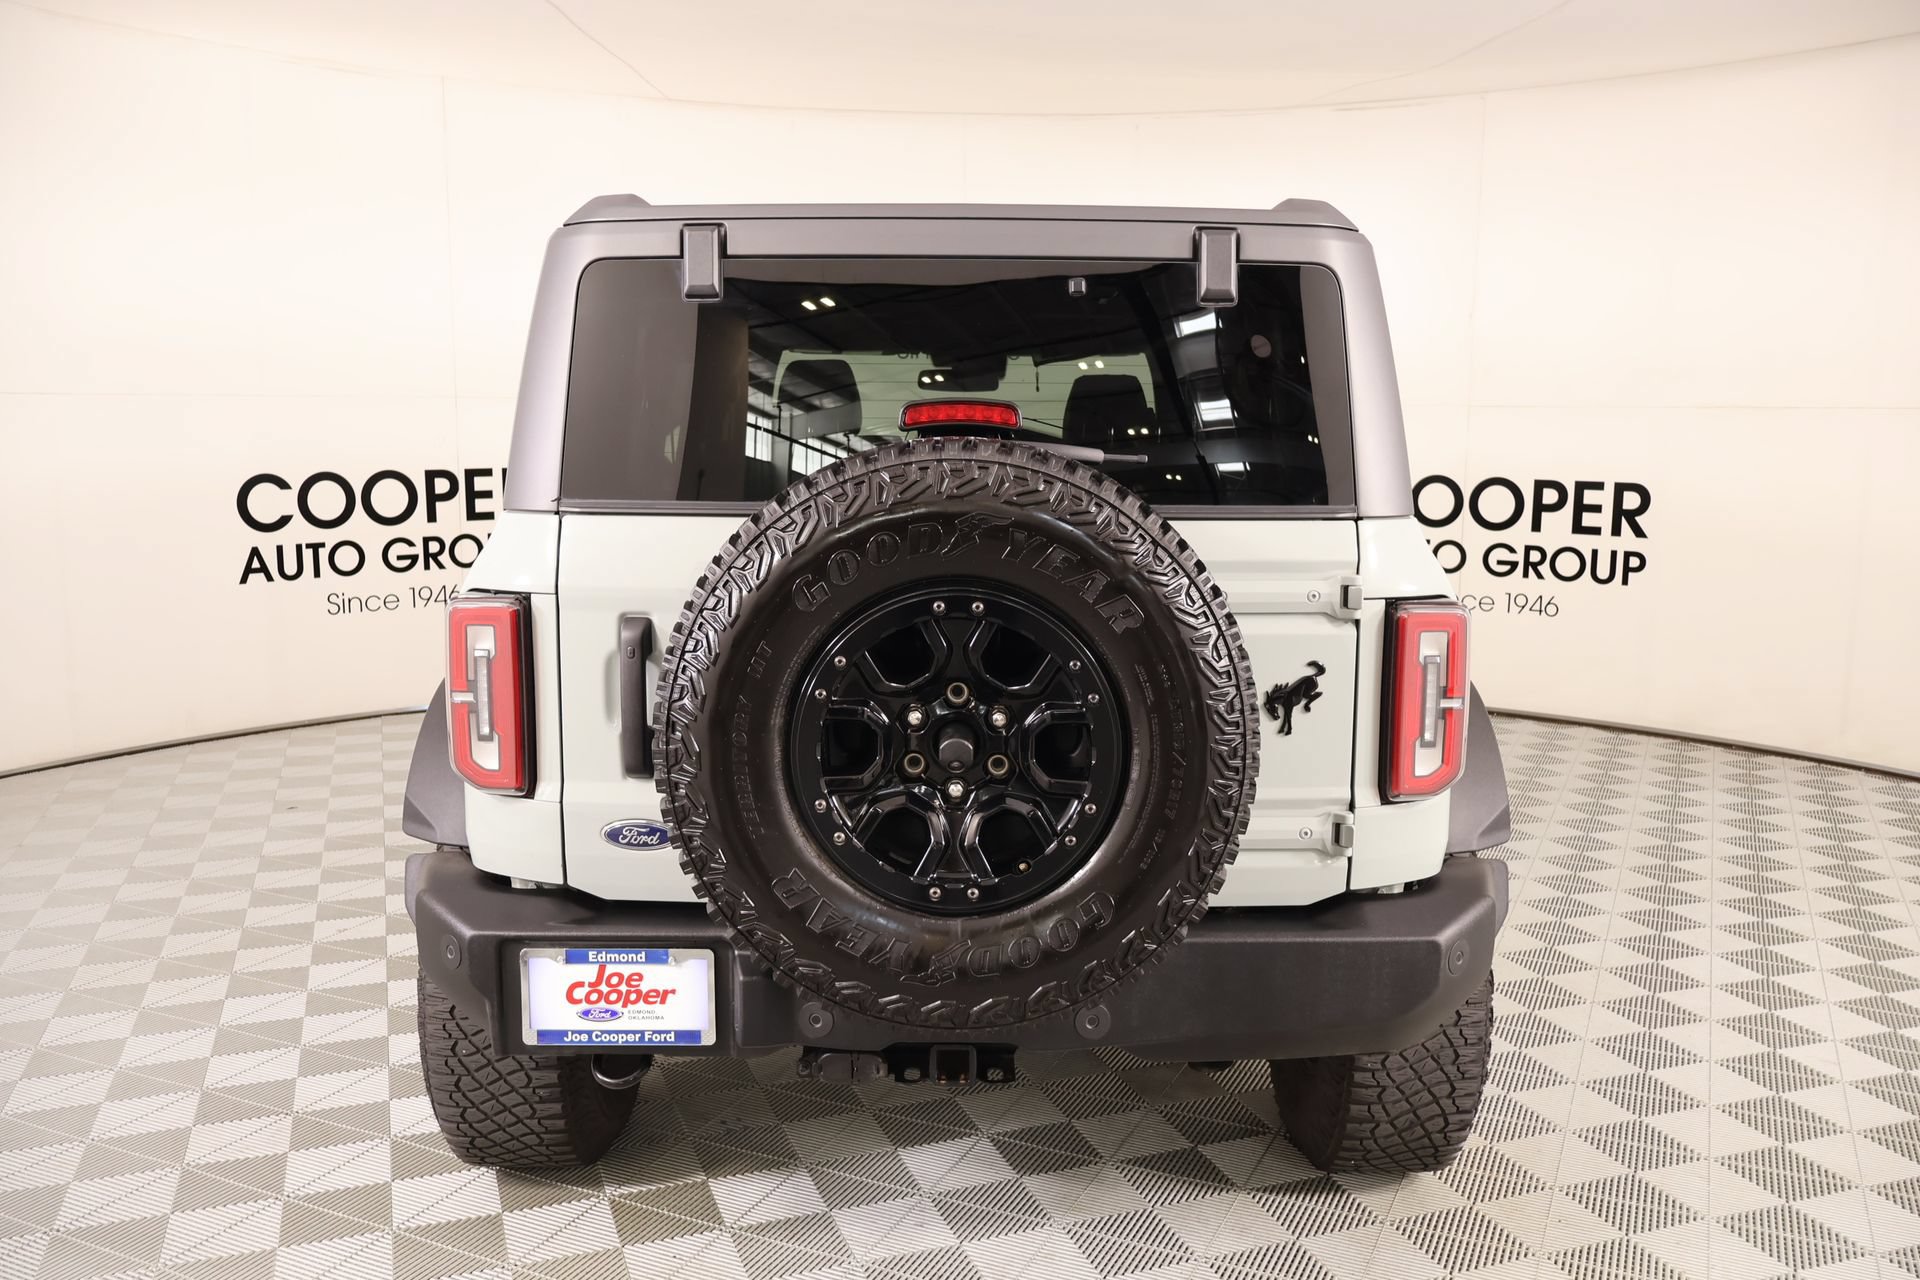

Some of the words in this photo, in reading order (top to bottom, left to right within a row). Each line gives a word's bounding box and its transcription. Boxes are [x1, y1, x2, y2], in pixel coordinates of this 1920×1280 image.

[236, 467, 508, 533] COOPE
[1412, 474, 1652, 539] OOPER
[239, 540, 366, 585] AUTO
[382, 533, 492, 573] GRO
[1482, 542, 1647, 586] GROUP
[327, 592, 400, 616] Since
[1505, 592, 1560, 617] 1946
[618, 826, 660, 845] Ford
[588, 950, 646, 962] Edmond
[588, 963, 644, 989] Joe
[565, 981, 676, 1008] Cooper
[588, 1008, 612, 1018] Ford
[564, 1031, 588, 1042] Joe
[592, 1031, 641, 1044] Cooper
[645, 1031, 675, 1042] Ford
